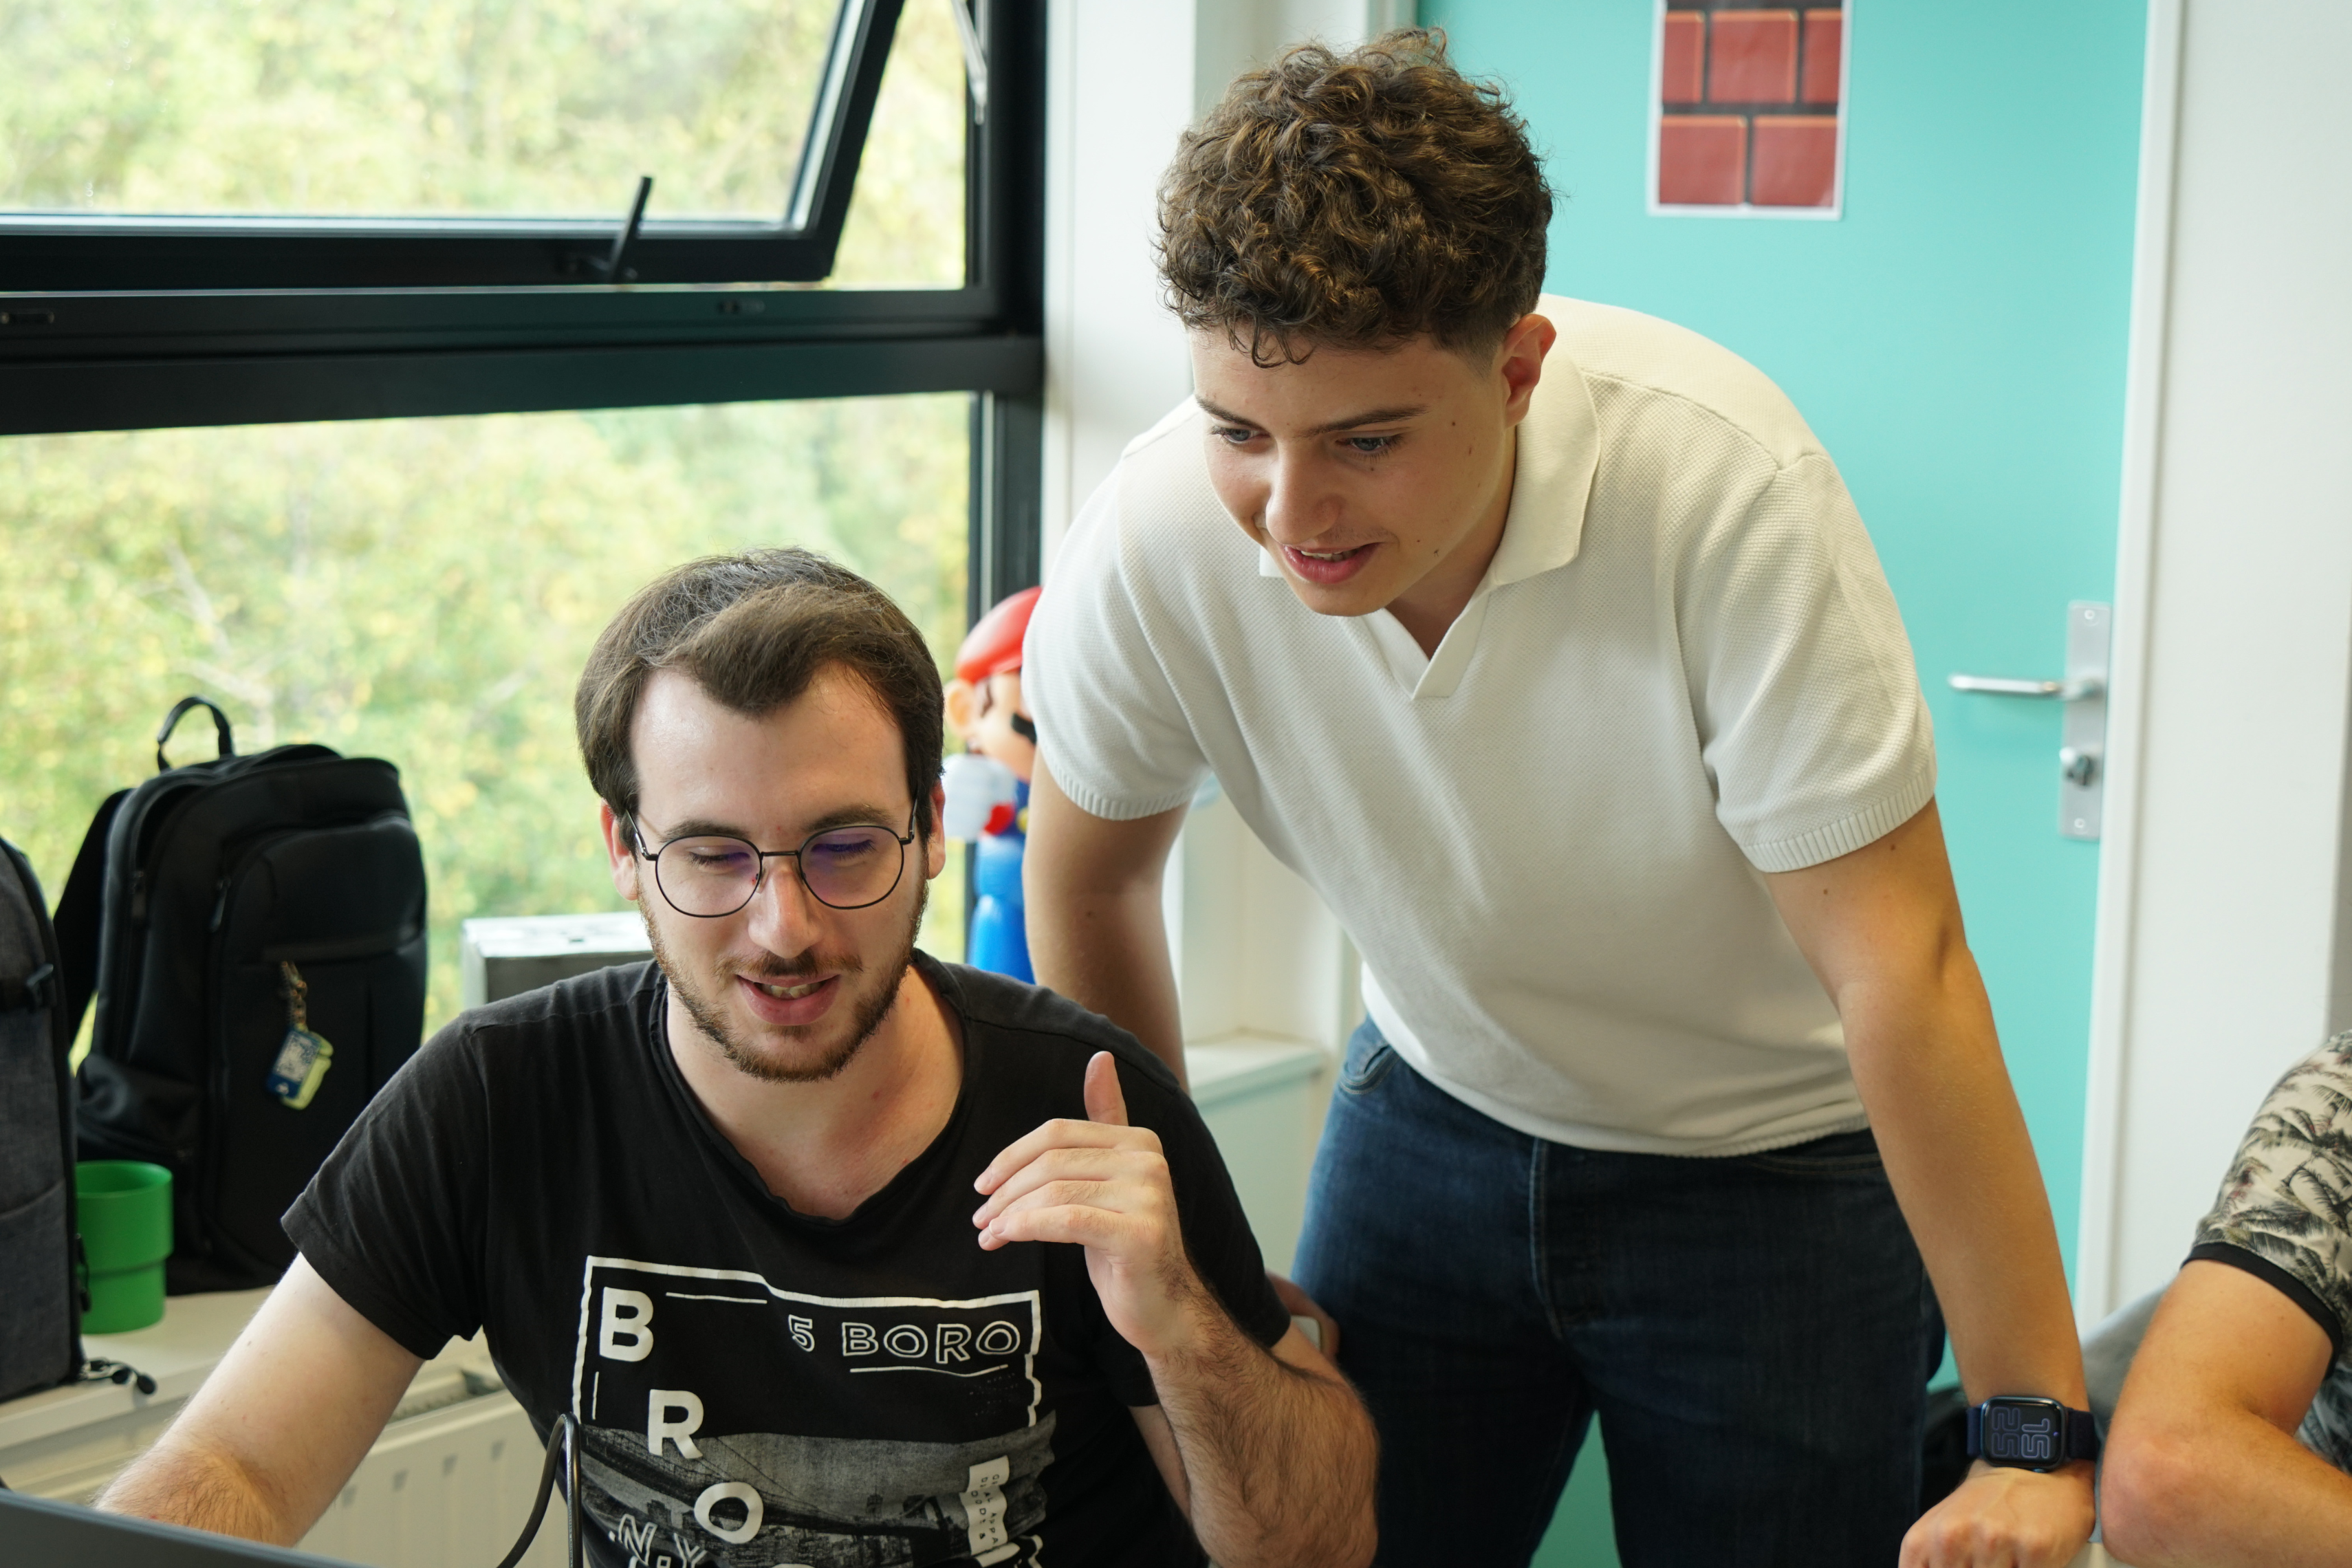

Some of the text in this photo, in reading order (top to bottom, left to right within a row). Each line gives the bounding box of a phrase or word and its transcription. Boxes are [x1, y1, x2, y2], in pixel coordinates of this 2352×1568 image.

[788, 1314, 1021, 1364] 5 BORO
[1991, 1406, 2021, 1457] 25
[2021, 1417, 2051, 1459] 15
